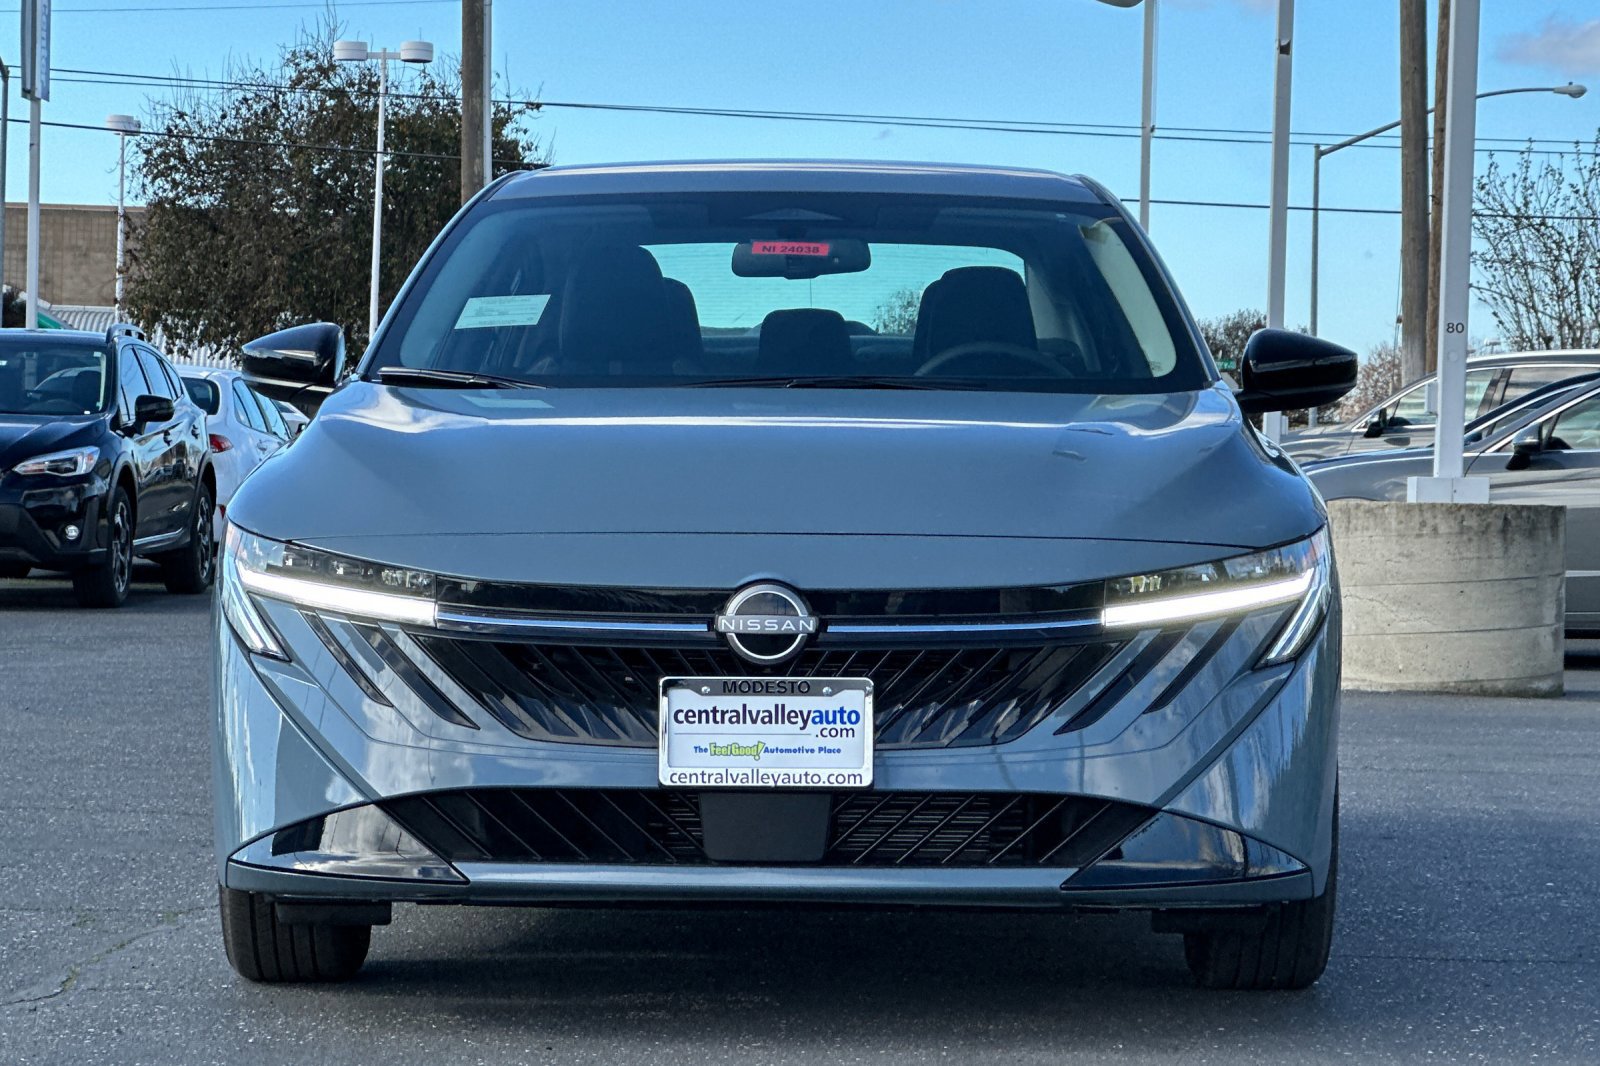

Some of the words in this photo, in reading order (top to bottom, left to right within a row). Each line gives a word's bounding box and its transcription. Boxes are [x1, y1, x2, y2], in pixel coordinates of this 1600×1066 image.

[762, 245, 775, 253] NI
[1446, 322, 1465, 334] 80
[721, 619, 813, 631] NISSAN
[722, 680, 811, 694] MODESTO
[673, 703, 861, 730] centralvalleyauto
[815, 726, 855, 738] .com
[693, 746, 708, 754] The
[763, 746, 815, 754] Automotive
[818, 746, 842, 754] Place
[669, 768, 863, 787] centralvalleyauto.com
